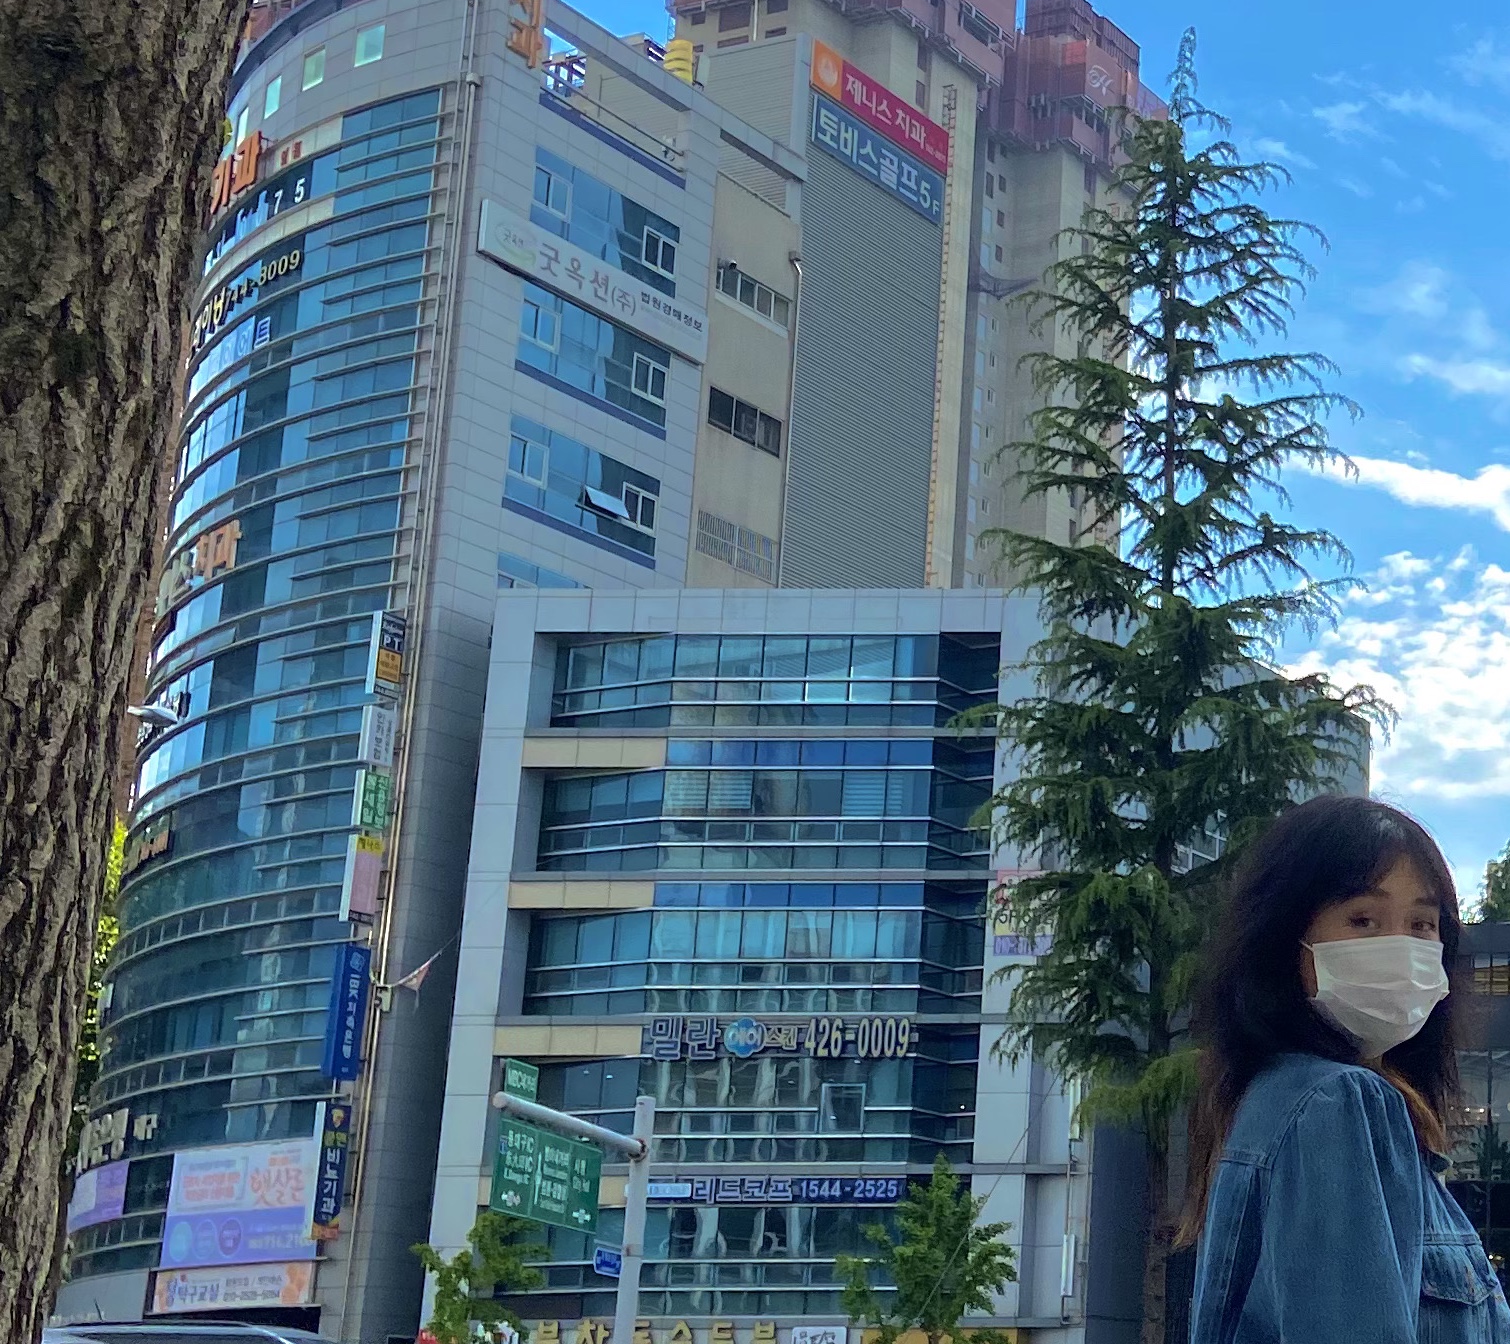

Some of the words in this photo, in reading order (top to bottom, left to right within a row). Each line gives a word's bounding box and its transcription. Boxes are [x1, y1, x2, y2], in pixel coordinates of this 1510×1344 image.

[844, 72, 893, 127] 제니스
[894, 107, 927, 151] 치과
[817, 106, 919, 204] 토비스골프
[538, 241, 637, 318] 굿옥션(주)
[639, 290, 704, 334] 법원경매정보
[650, 1016, 722, 1061] 밀란
[804, 1017, 912, 1058] 426-0009
[250, 1167, 304, 1206] 햇살론
[693, 1174, 793, 1205] 리드코프
[799, 1179, 899, 1199] 1544-2525
